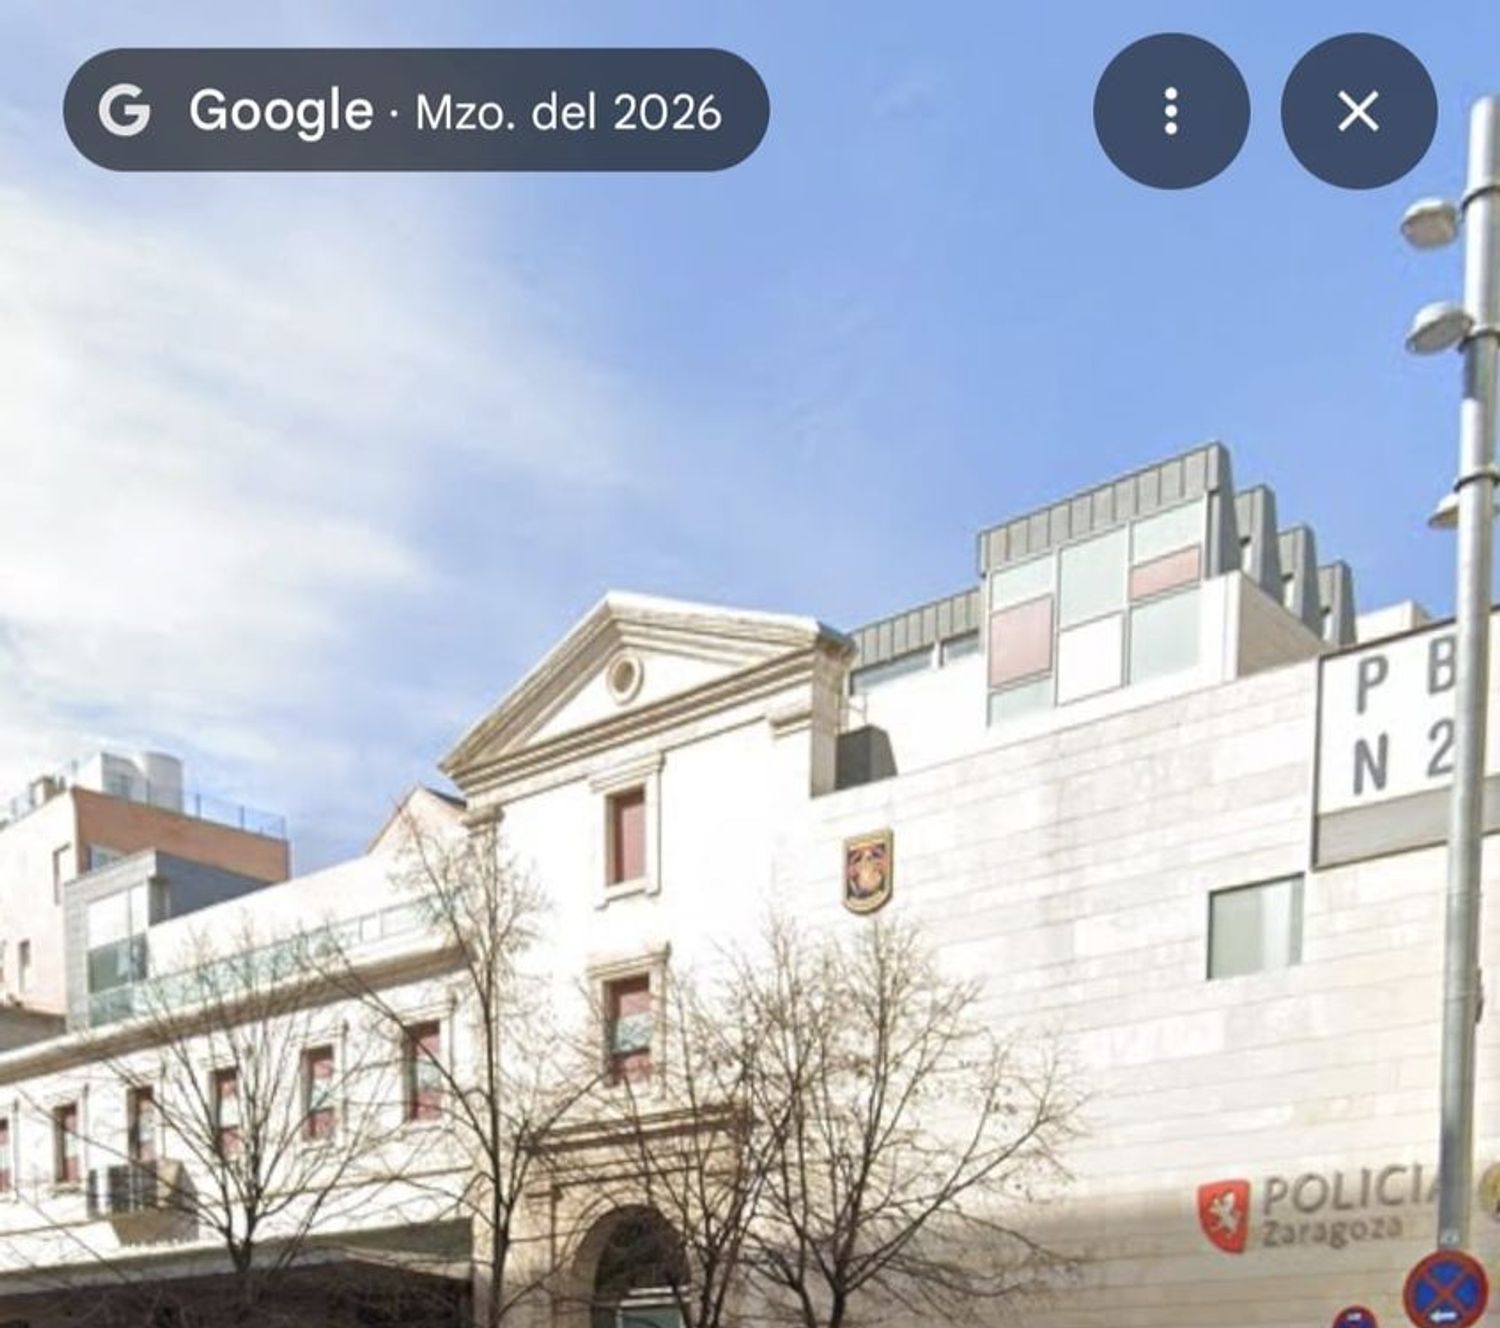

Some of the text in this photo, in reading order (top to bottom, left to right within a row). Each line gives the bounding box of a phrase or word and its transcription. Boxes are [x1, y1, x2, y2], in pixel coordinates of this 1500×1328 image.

[1354, 655, 1390, 716] P
[1352, 732, 1389, 796] N
[1263, 1216, 1404, 1250] Zaragoza
